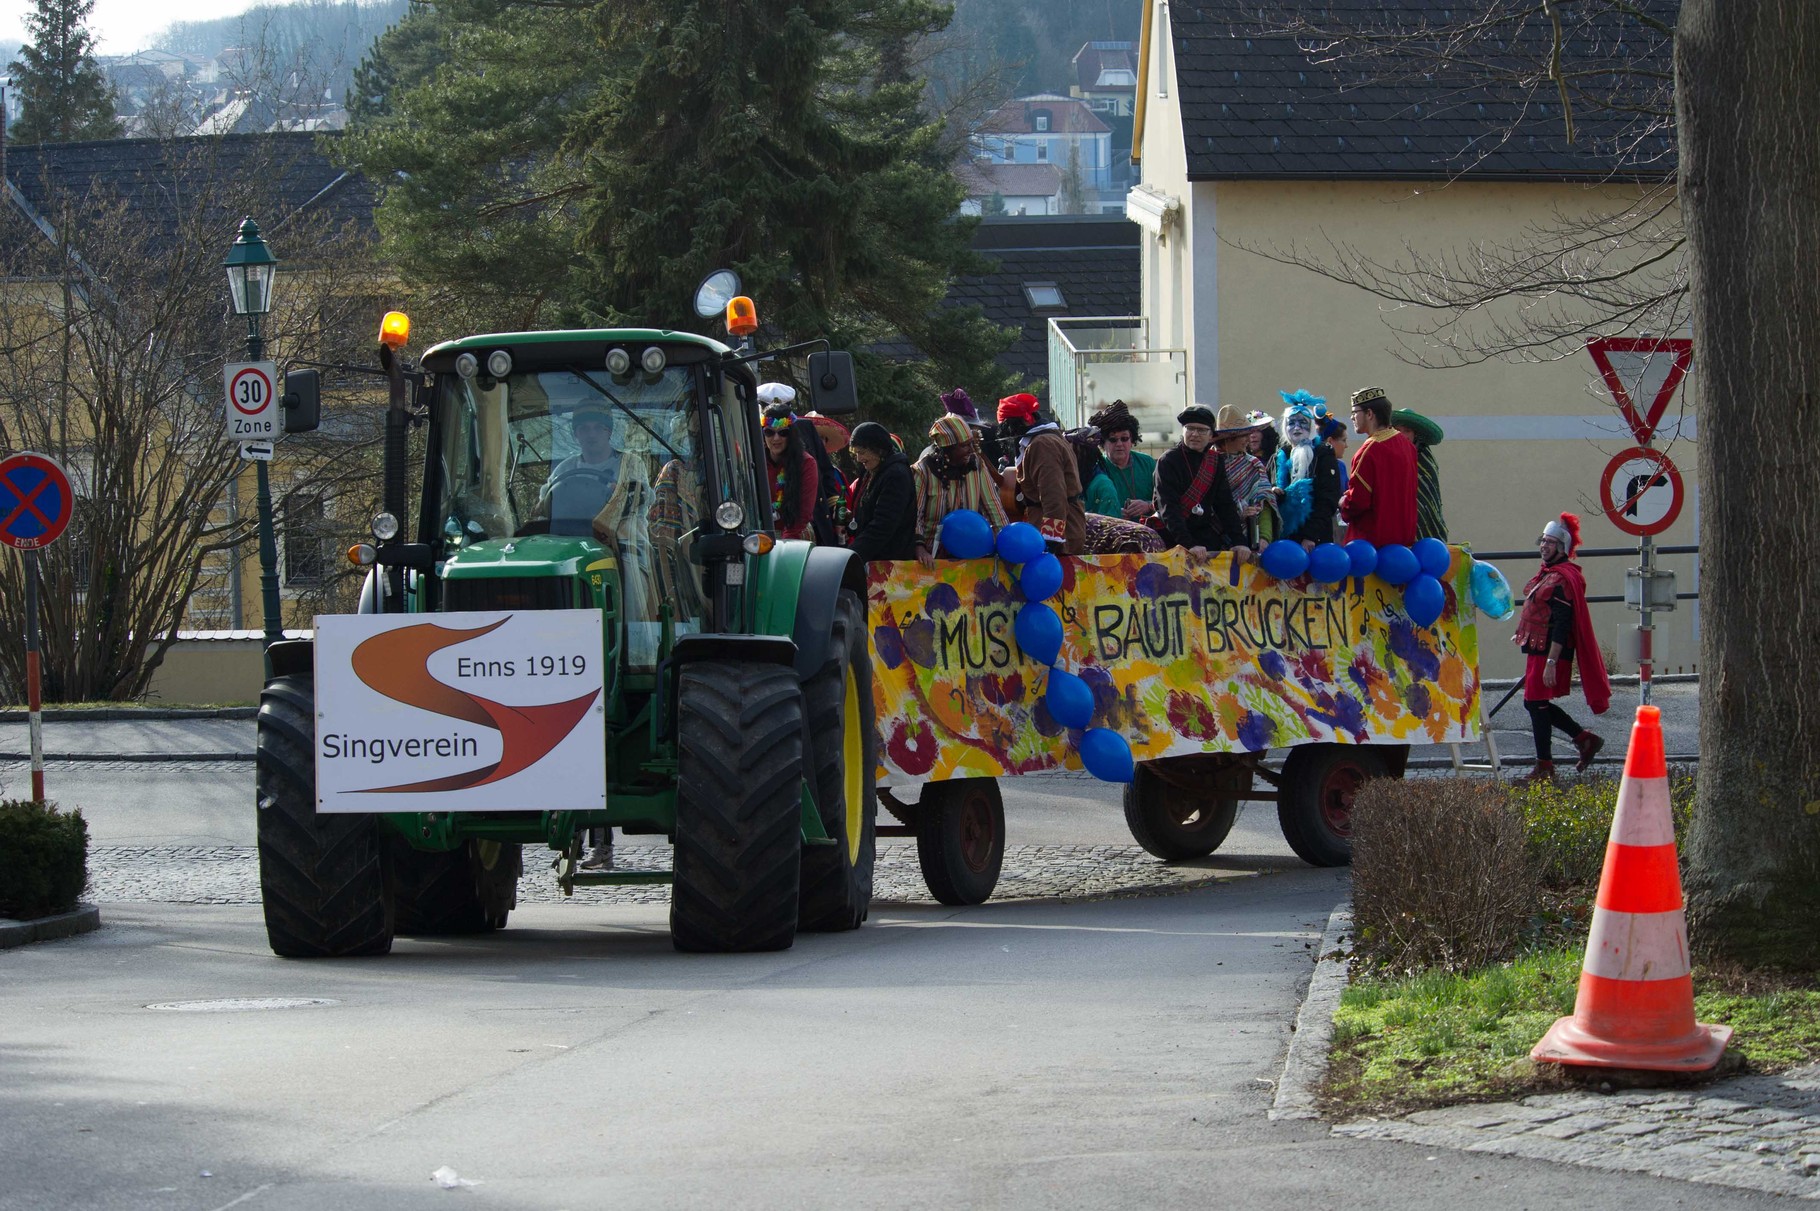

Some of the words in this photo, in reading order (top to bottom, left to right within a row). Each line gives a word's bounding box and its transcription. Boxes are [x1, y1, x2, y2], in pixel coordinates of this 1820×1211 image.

[240, 380, 261, 403] 30
[235, 420, 272, 433] Zone
[14, 537, 41, 547] ENDE
[940, 609, 1037, 670] MUSI
[1094, 599, 1189, 660] BAUT
[1204, 595, 1348, 653] BRÜCKEN
[457, 657, 515, 677] Enns
[526, 655, 586, 676] 1919
[322, 733, 478, 763] Singverein
